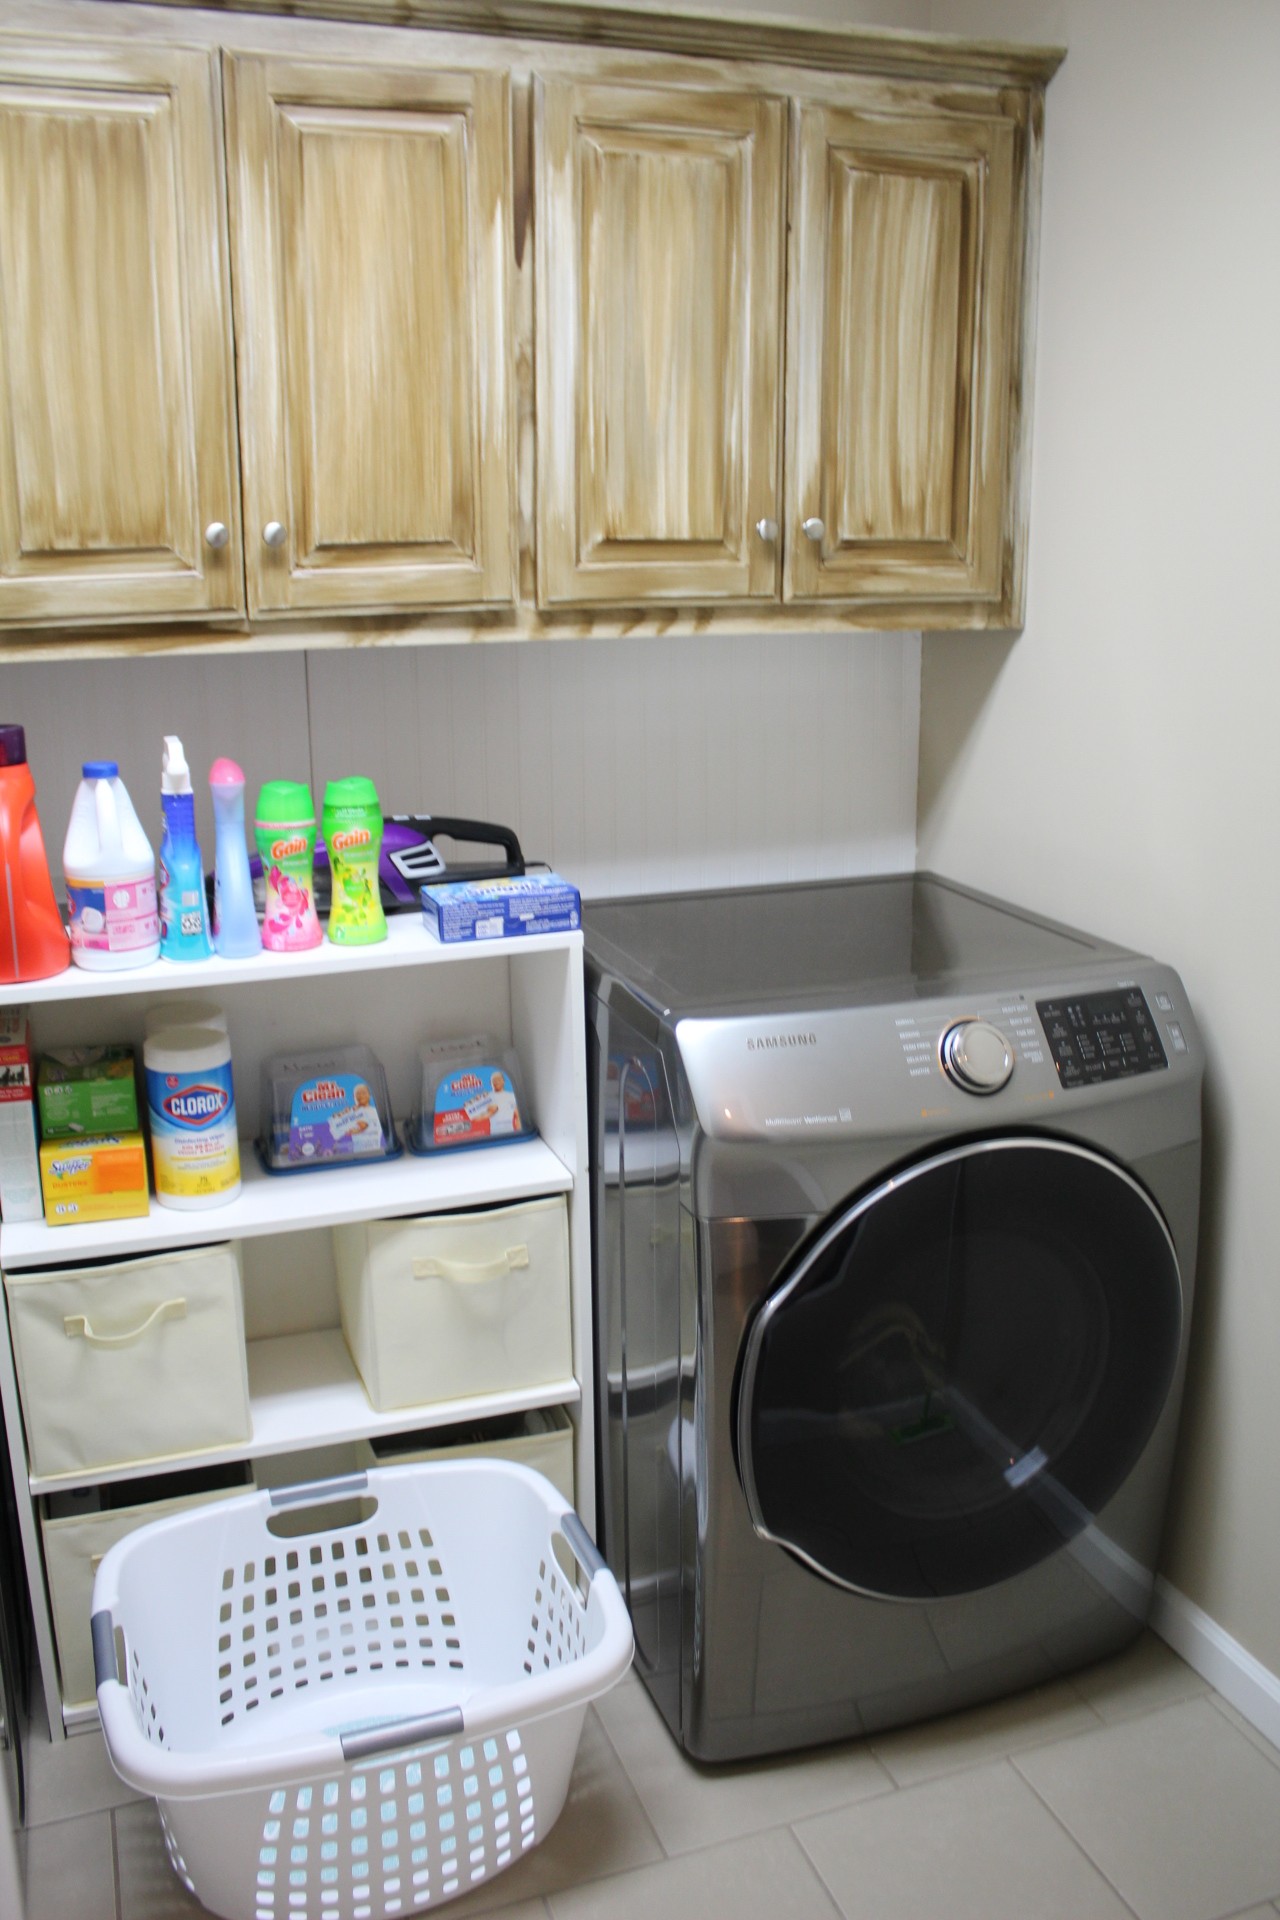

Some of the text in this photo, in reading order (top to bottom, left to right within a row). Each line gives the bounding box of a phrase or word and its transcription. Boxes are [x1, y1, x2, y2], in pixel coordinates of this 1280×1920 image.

[271, 837, 308, 860] Gain
[332, 829, 371, 851] Gain
[745, 1032, 817, 1051] SAMSUNG
[170, 1093, 223, 1116] CLOROX
[302, 1088, 345, 1104] Clean
[50, 1158, 92, 1177] Swiffer
